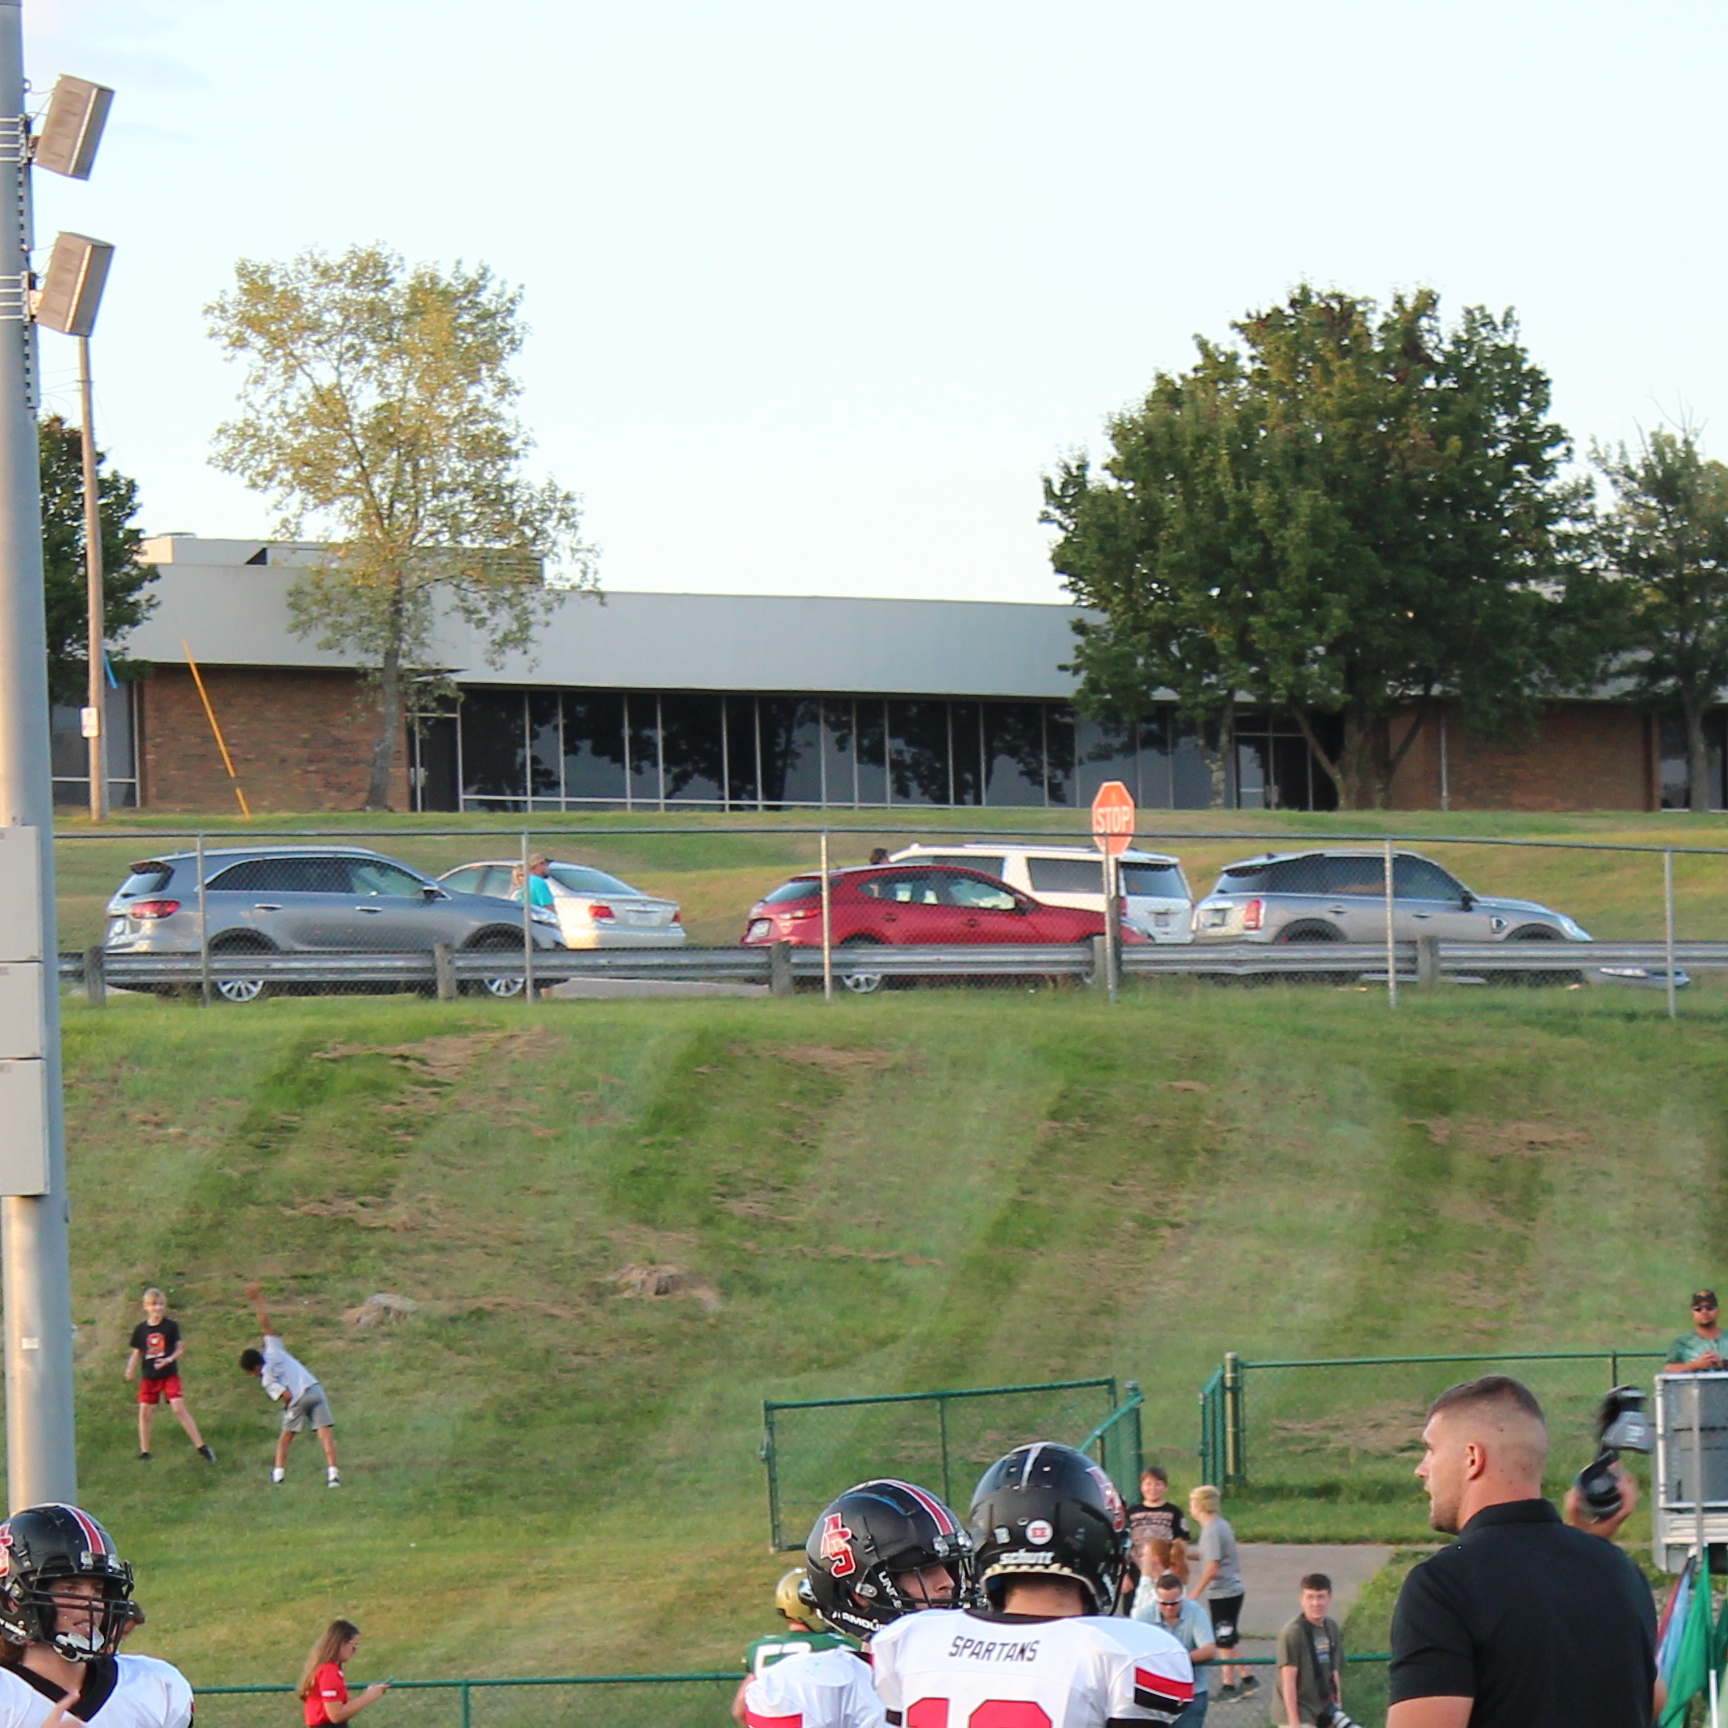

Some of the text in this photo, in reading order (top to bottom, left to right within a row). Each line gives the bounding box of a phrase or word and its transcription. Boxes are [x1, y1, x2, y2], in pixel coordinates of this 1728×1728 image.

[1097, 806, 1130, 833] STOP
[999, 1548, 1055, 1565] schutt
[948, 1635, 1040, 1662] SPARTANS
